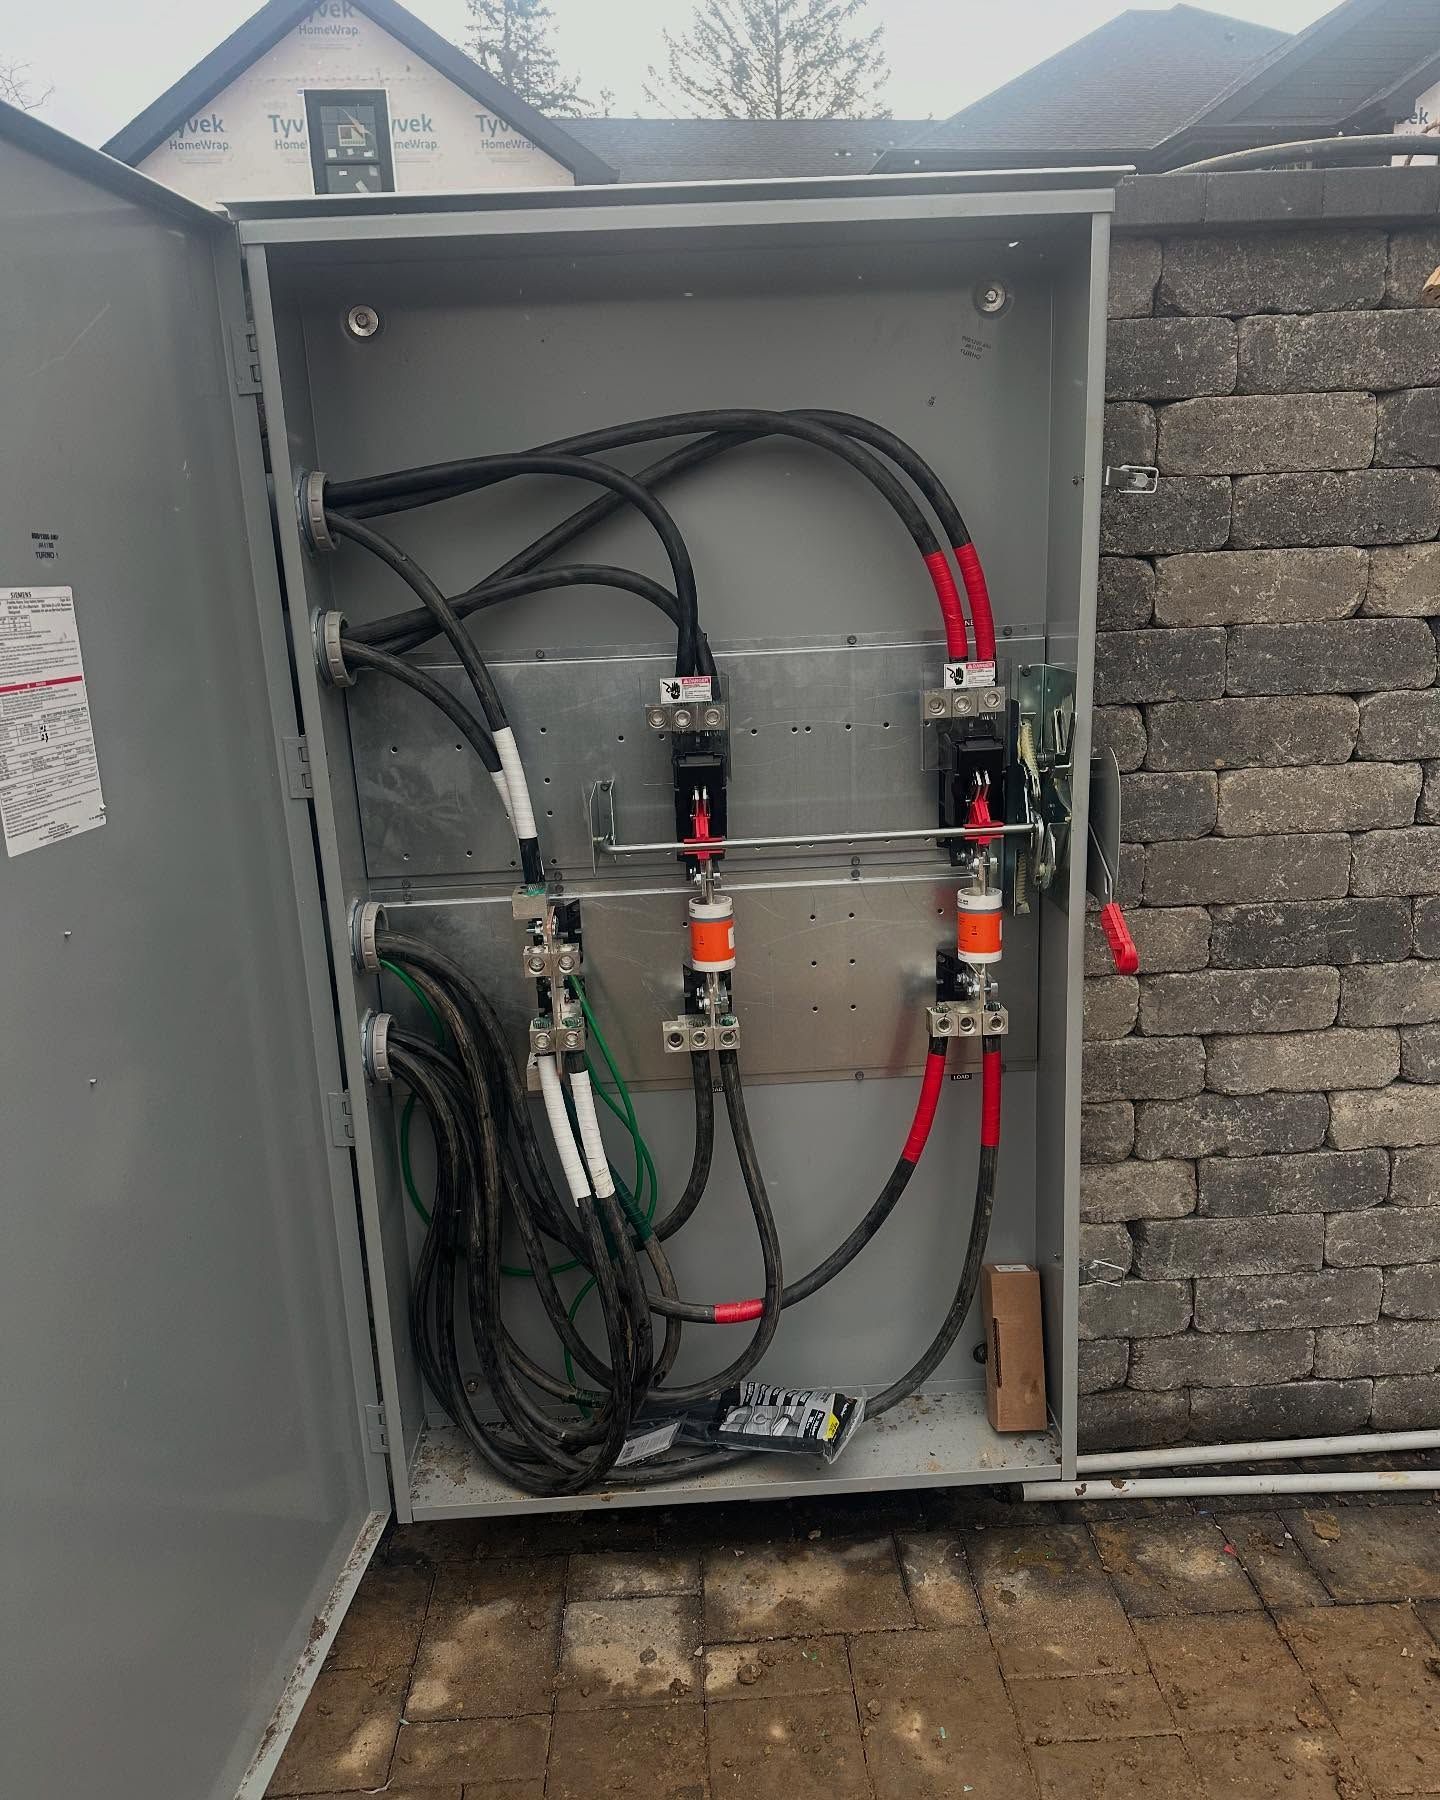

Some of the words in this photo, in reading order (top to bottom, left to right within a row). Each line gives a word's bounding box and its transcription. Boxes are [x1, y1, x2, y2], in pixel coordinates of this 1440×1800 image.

[174, 114, 225, 138] yvek
[268, 114, 304, 138] Tyv
[475, 114, 514, 137] Tyv
[275, 139, 307, 149] Home
[394, 139, 438, 151] meWrap
